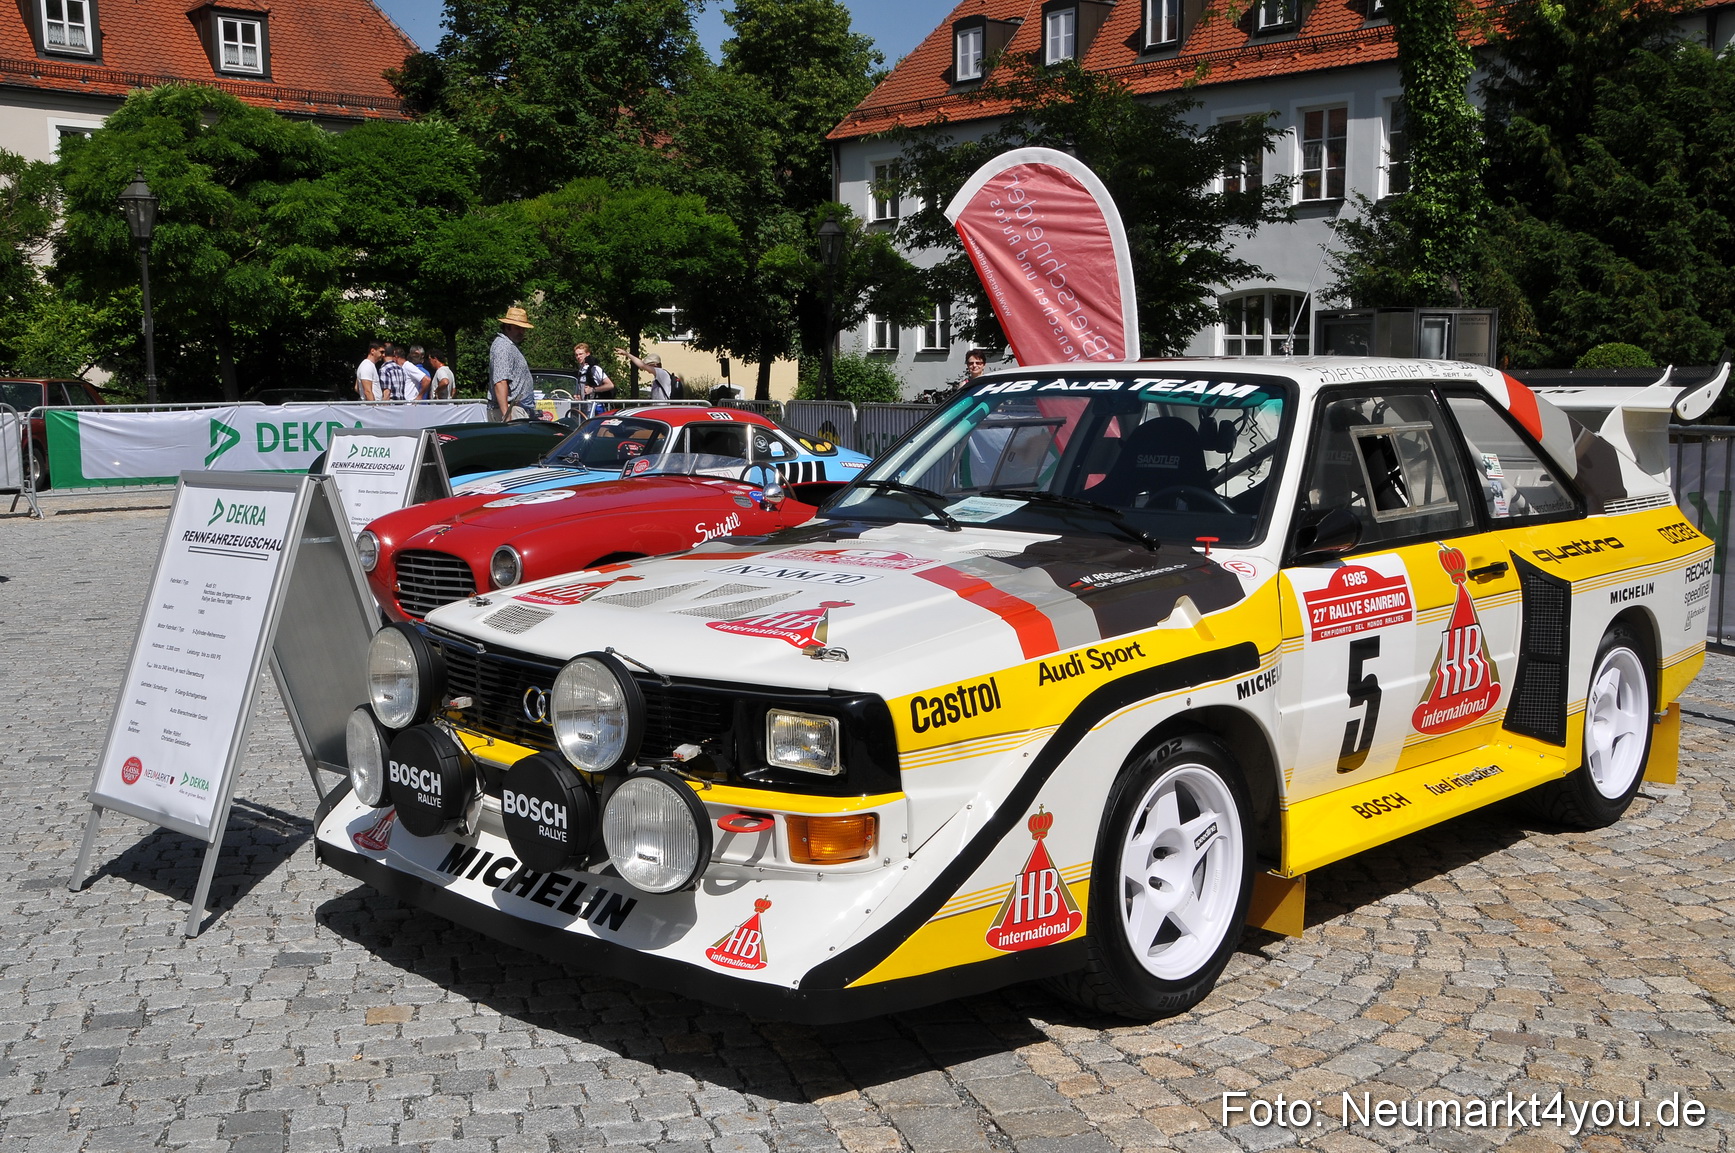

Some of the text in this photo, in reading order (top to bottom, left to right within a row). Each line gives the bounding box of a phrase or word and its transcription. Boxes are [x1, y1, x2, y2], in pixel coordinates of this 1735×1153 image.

[1320, 364, 1424, 382] Bierschneider
[975, 378, 1262, 398] HB Audi TEAM
[257, 421, 364, 452] DEK
[360, 446, 391, 458] DEKRA
[1137, 454, 1180, 466] SANDTLER
[330, 461, 405, 472] RENNFAHRZEUGSCHAU
[226, 503, 266, 526] DEKRA
[182, 530, 283, 552] RENNFAHRZEUGSCHAU
[1657, 522, 1700, 544] BOGE
[1532, 537, 1624, 564] quattro
[718, 564, 866, 584] IN-NM 70
[1342, 571, 1368, 587] 1985
[1685, 558, 1712, 584] RECARO
[1610, 582, 1655, 604] MICHELIN
[1330, 600, 1363, 620] RALLYE
[1364, 592, 1406, 612] SANREMO
[745, 611, 826, 630] HB
[1321, 625, 1352, 639] CAMPIONATO
[1355, 623, 1364, 632] DEL
[1367, 620, 1382, 629] MONDO
[715, 624, 810, 646] international
[1038, 641, 1146, 687] Audi Sport
[1440, 622, 1484, 700] HB
[1236, 663, 1283, 700] MICHELI
[910, 676, 1002, 734] Castrol
[1336, 635, 1382, 774] 5
[1421, 692, 1490, 729] international
[578, 732, 594, 741] BOSCH
[144, 768, 170, 784] NEUMARKT
[189, 776, 210, 792] DEKRA
[389, 760, 442, 796] BOSCH
[1424, 776, 1453, 797] fuel
[417, 792, 442, 808] RALLYE
[503, 789, 568, 830] BOSCH
[1351, 792, 1412, 820] BOSCH
[368, 819, 392, 842] HB
[538, 824, 568, 843] RALLYE
[436, 842, 638, 932] MICHELIN
[1012, 866, 1058, 924] HB
[724, 926, 763, 960] HB
[998, 918, 1070, 947] international
[710, 952, 759, 970] international
